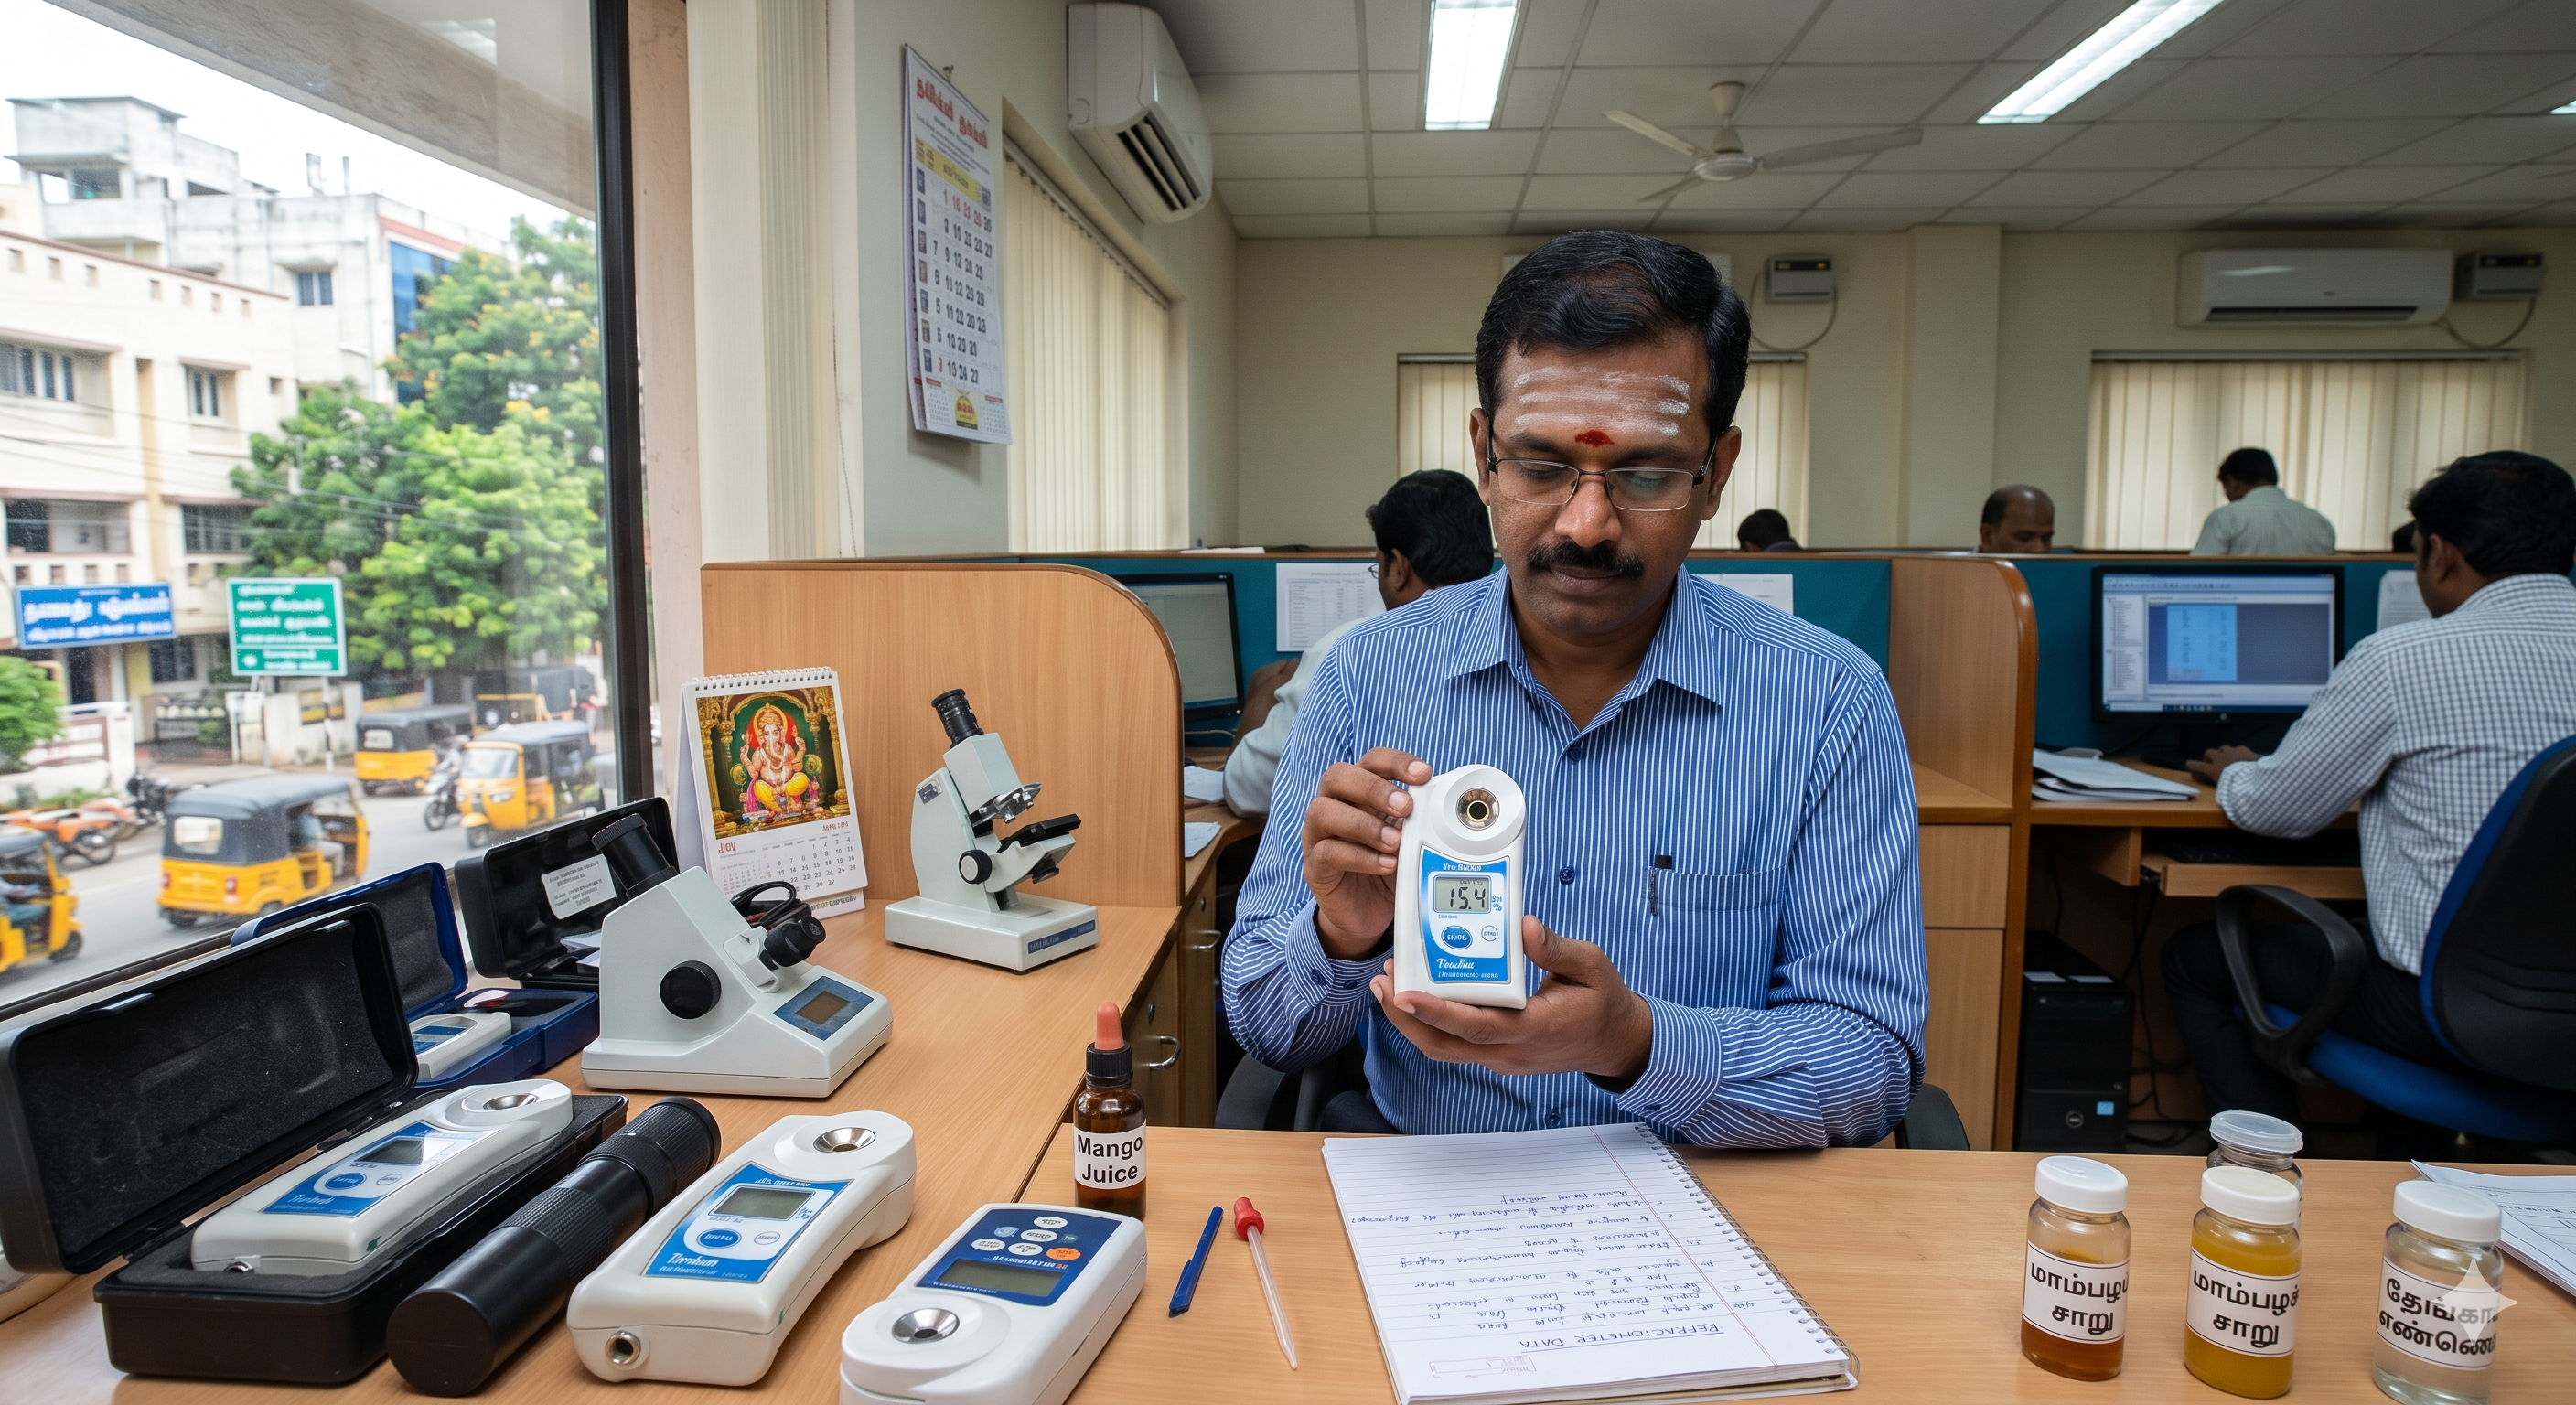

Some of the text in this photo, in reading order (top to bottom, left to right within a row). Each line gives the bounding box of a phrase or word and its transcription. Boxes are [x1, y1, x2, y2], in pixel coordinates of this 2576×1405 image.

[1450, 886, 1487, 910] 15.4
[1078, 1134, 1143, 1161] Mango
[1081, 1164, 1138, 1184] Juice
[2052, 1305, 2114, 1336] சாறு
[2213, 1314, 2280, 1349] சாறு
[1519, 1337, 1564, 1348] DATA
